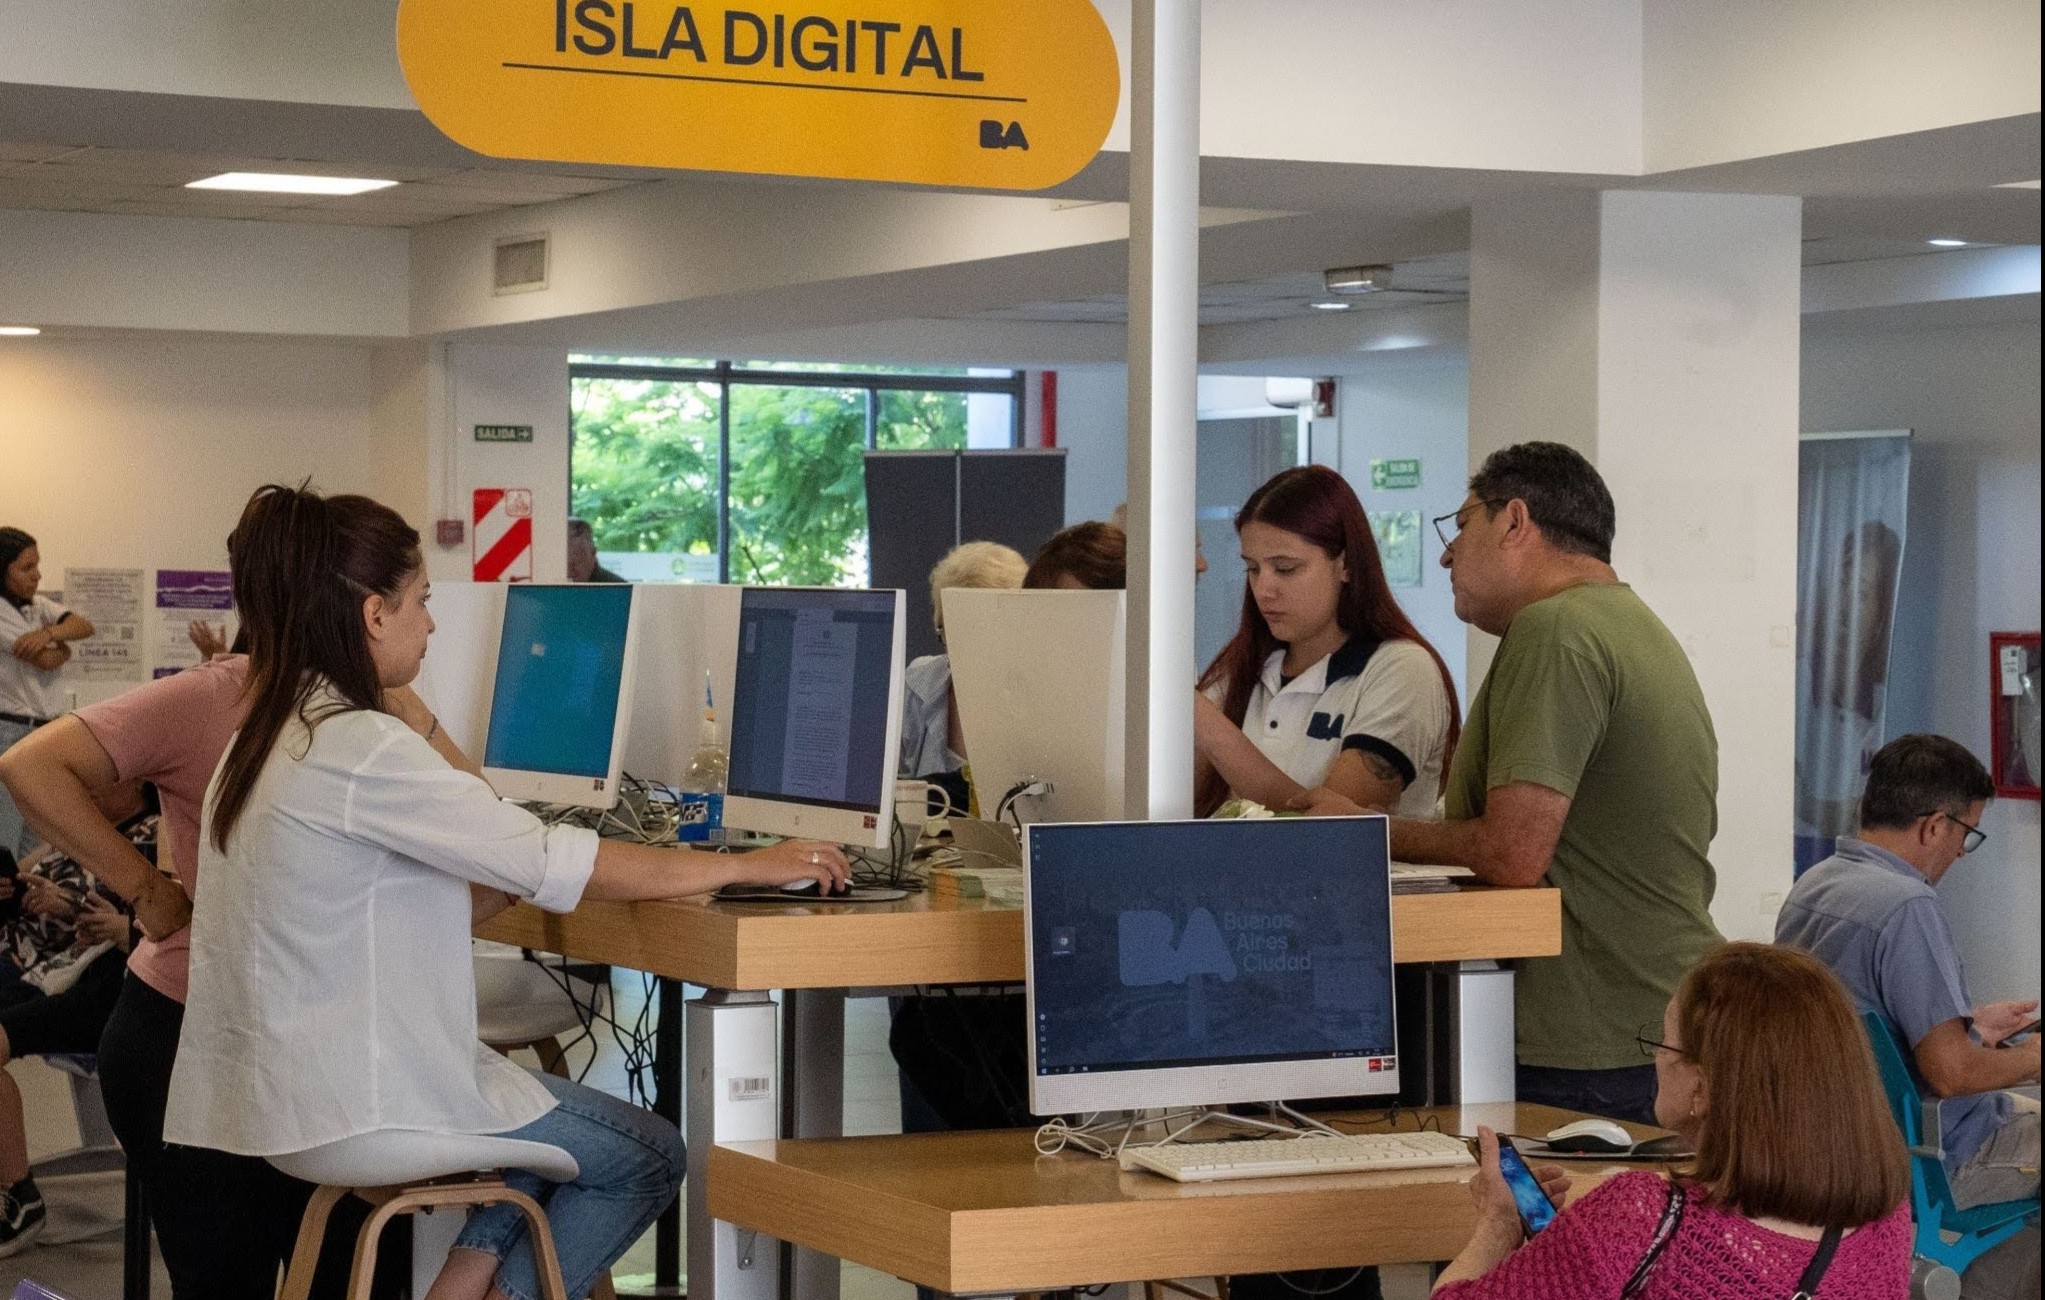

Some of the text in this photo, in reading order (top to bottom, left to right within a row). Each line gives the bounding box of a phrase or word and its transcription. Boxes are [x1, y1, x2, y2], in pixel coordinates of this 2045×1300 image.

[555, 0, 985, 82] ISLA DIGITAL
[979, 119, 1030, 151] BA
[477, 427, 516, 439] SALIDA
[1224, 911, 1294, 931] Buenos
[1118, 907, 1238, 986] BA
[1237, 932, 1289, 951] Aires
[1243, 952, 1312, 972] Ciudad
